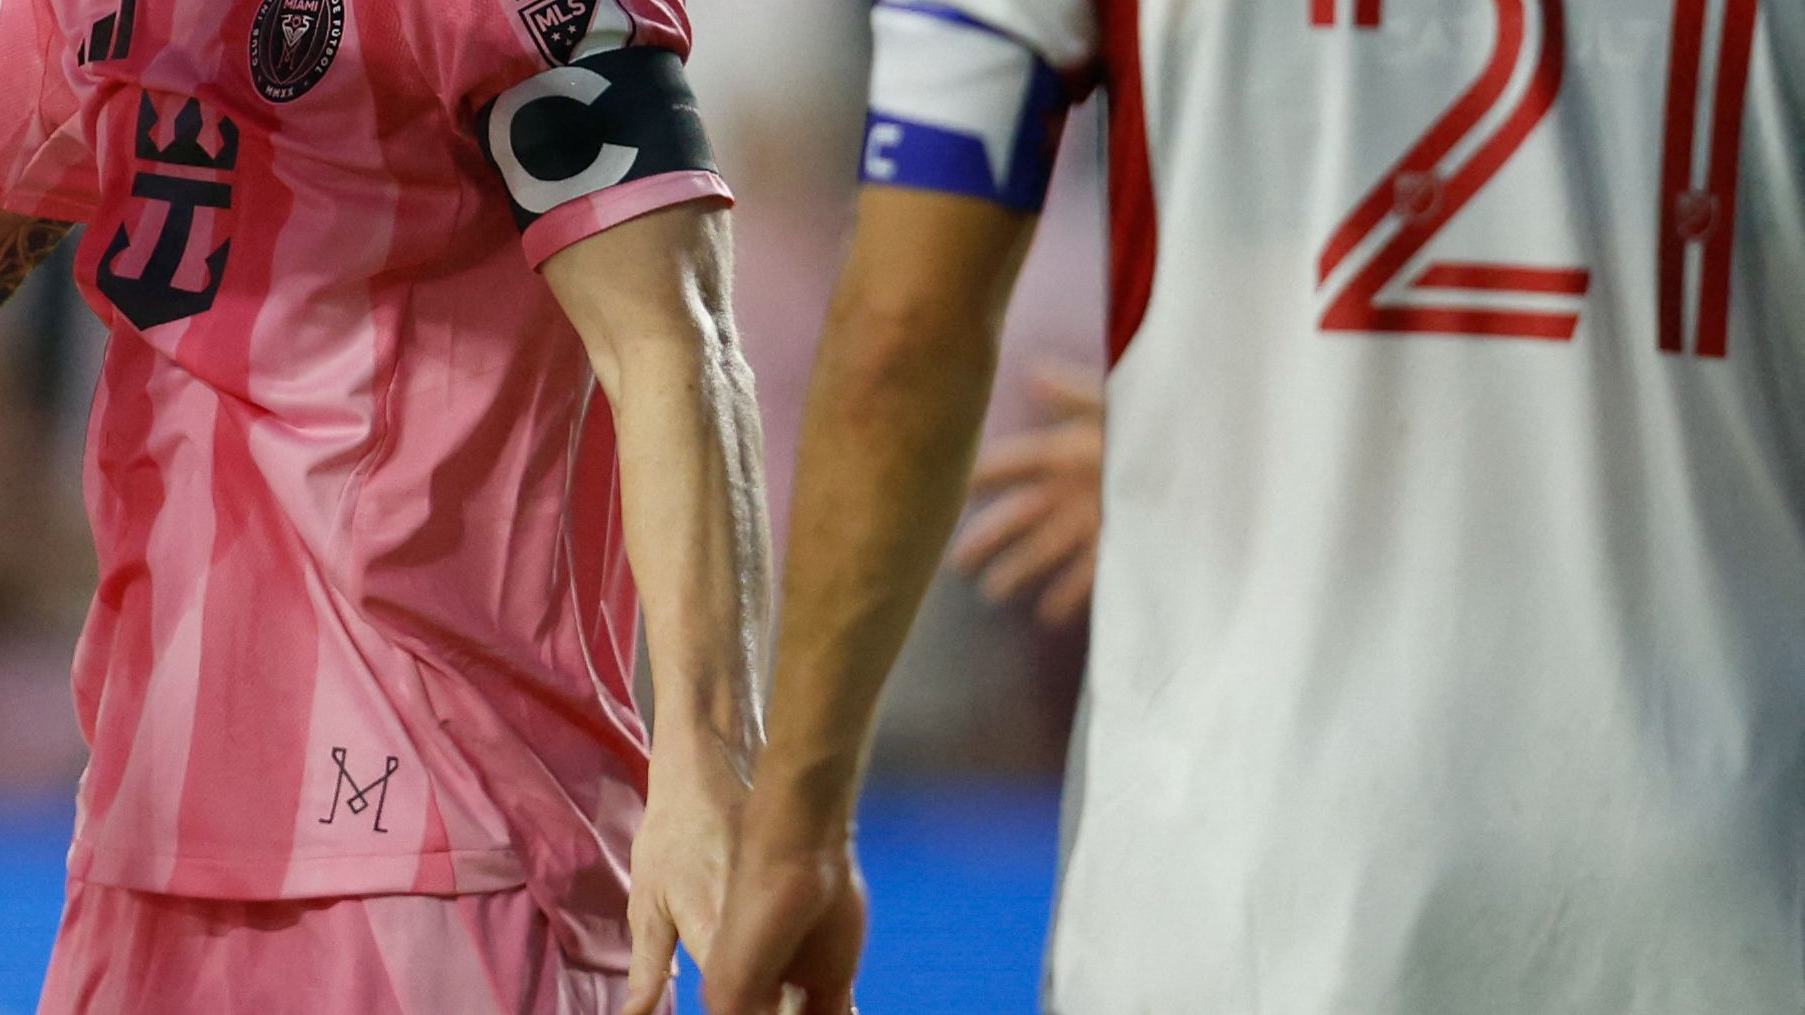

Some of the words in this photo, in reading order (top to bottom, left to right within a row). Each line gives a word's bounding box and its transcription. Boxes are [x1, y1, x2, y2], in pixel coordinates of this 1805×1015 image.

[251, 28, 260, 66] CLUB
[265, 85, 295, 100] MMXX
[489, 66, 639, 214] C
[864, 122, 903, 179] C
